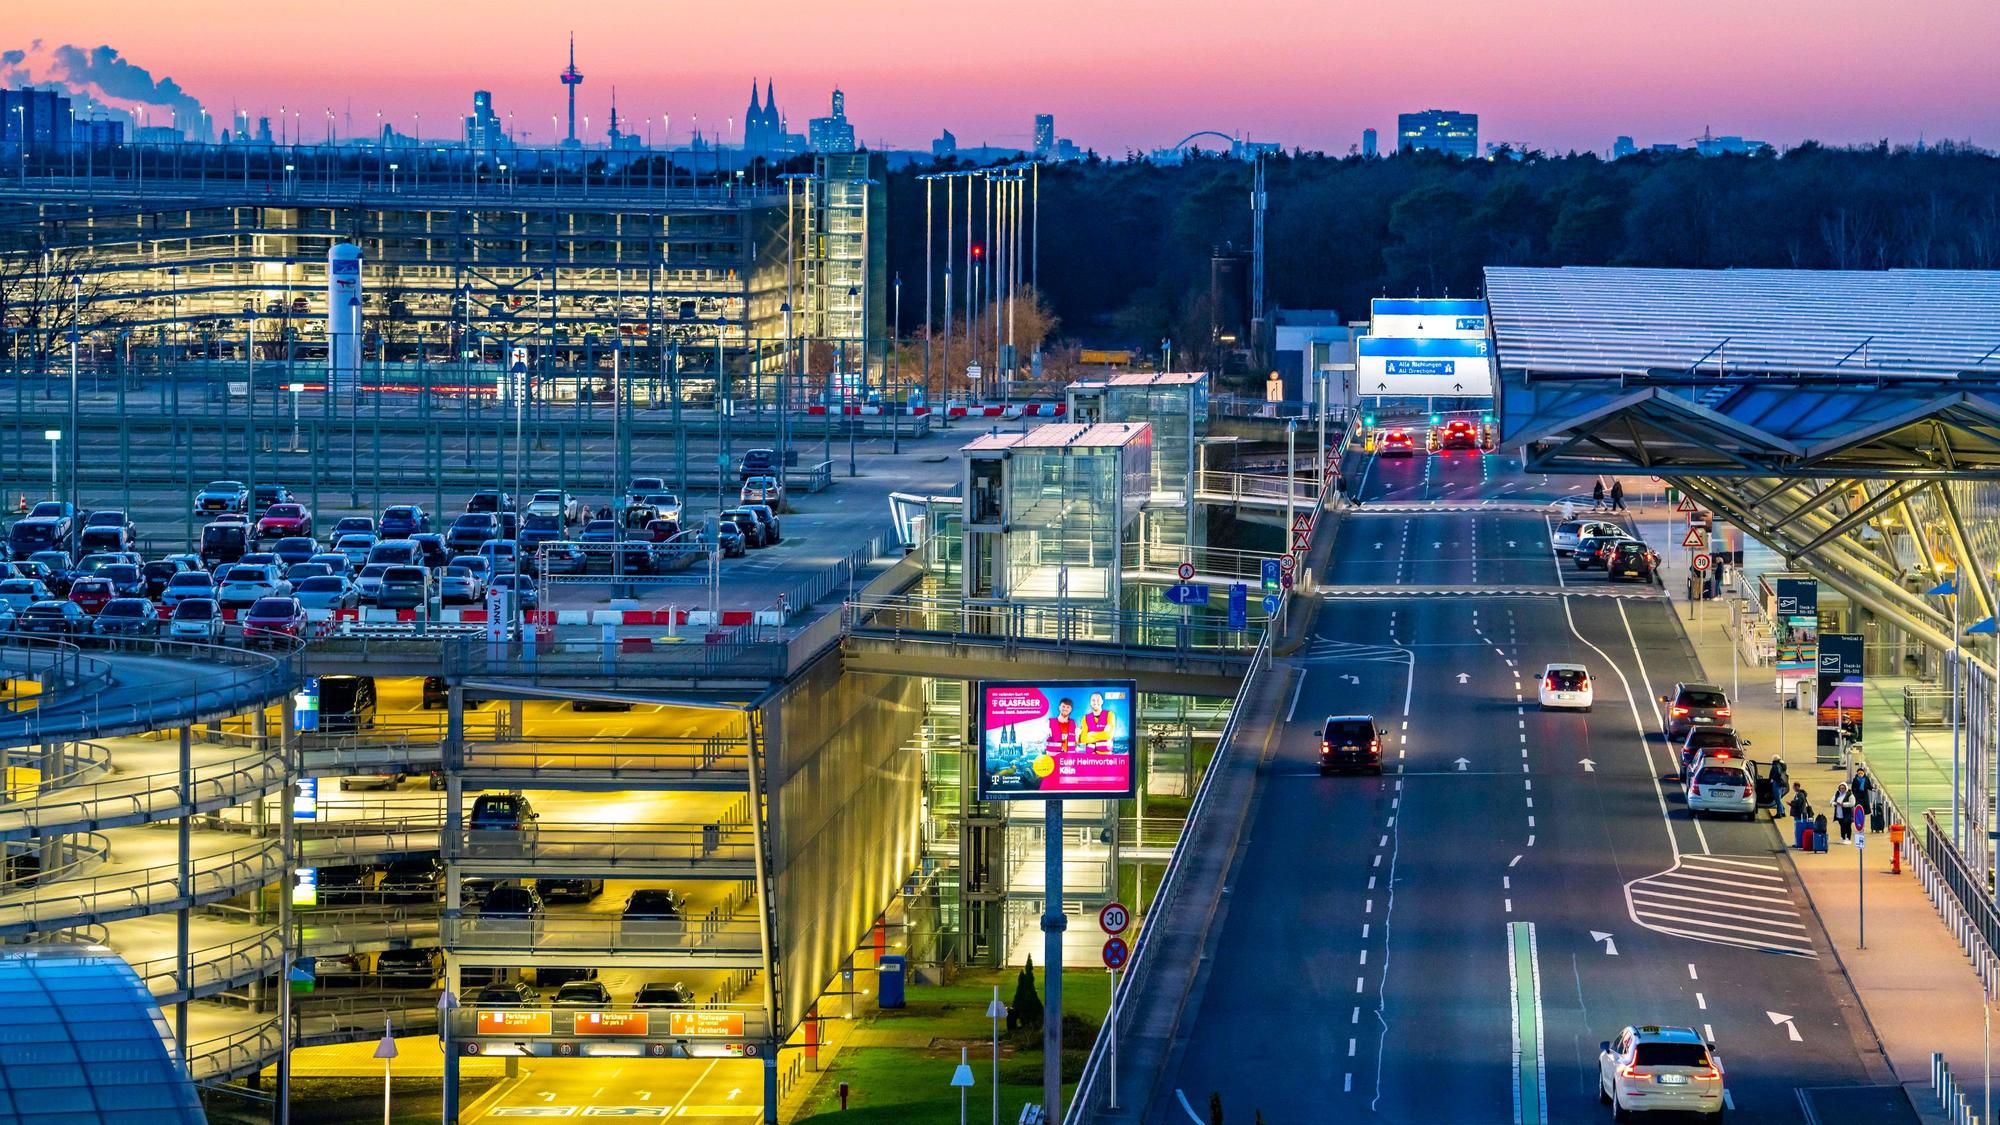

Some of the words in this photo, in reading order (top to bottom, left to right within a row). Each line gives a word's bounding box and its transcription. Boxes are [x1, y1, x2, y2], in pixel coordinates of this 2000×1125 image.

[1282, 558, 1293, 567] 30
[1697, 558, 1707, 567] 30
[493, 598, 501, 625] TANK
[998, 699, 1041, 707] GLASFASER
[1059, 757, 1076, 766] Euer
[1076, 757, 1117, 766] Heimvorteil
[1118, 757, 1126, 766] in
[1059, 766, 1076, 775] Köln
[1106, 911, 1123, 926] 30
[505, 1012, 531, 1020] Parkhaus
[602, 1013, 628, 1021] Parkhaus
[697, 1013, 729, 1022] Mietwagen
